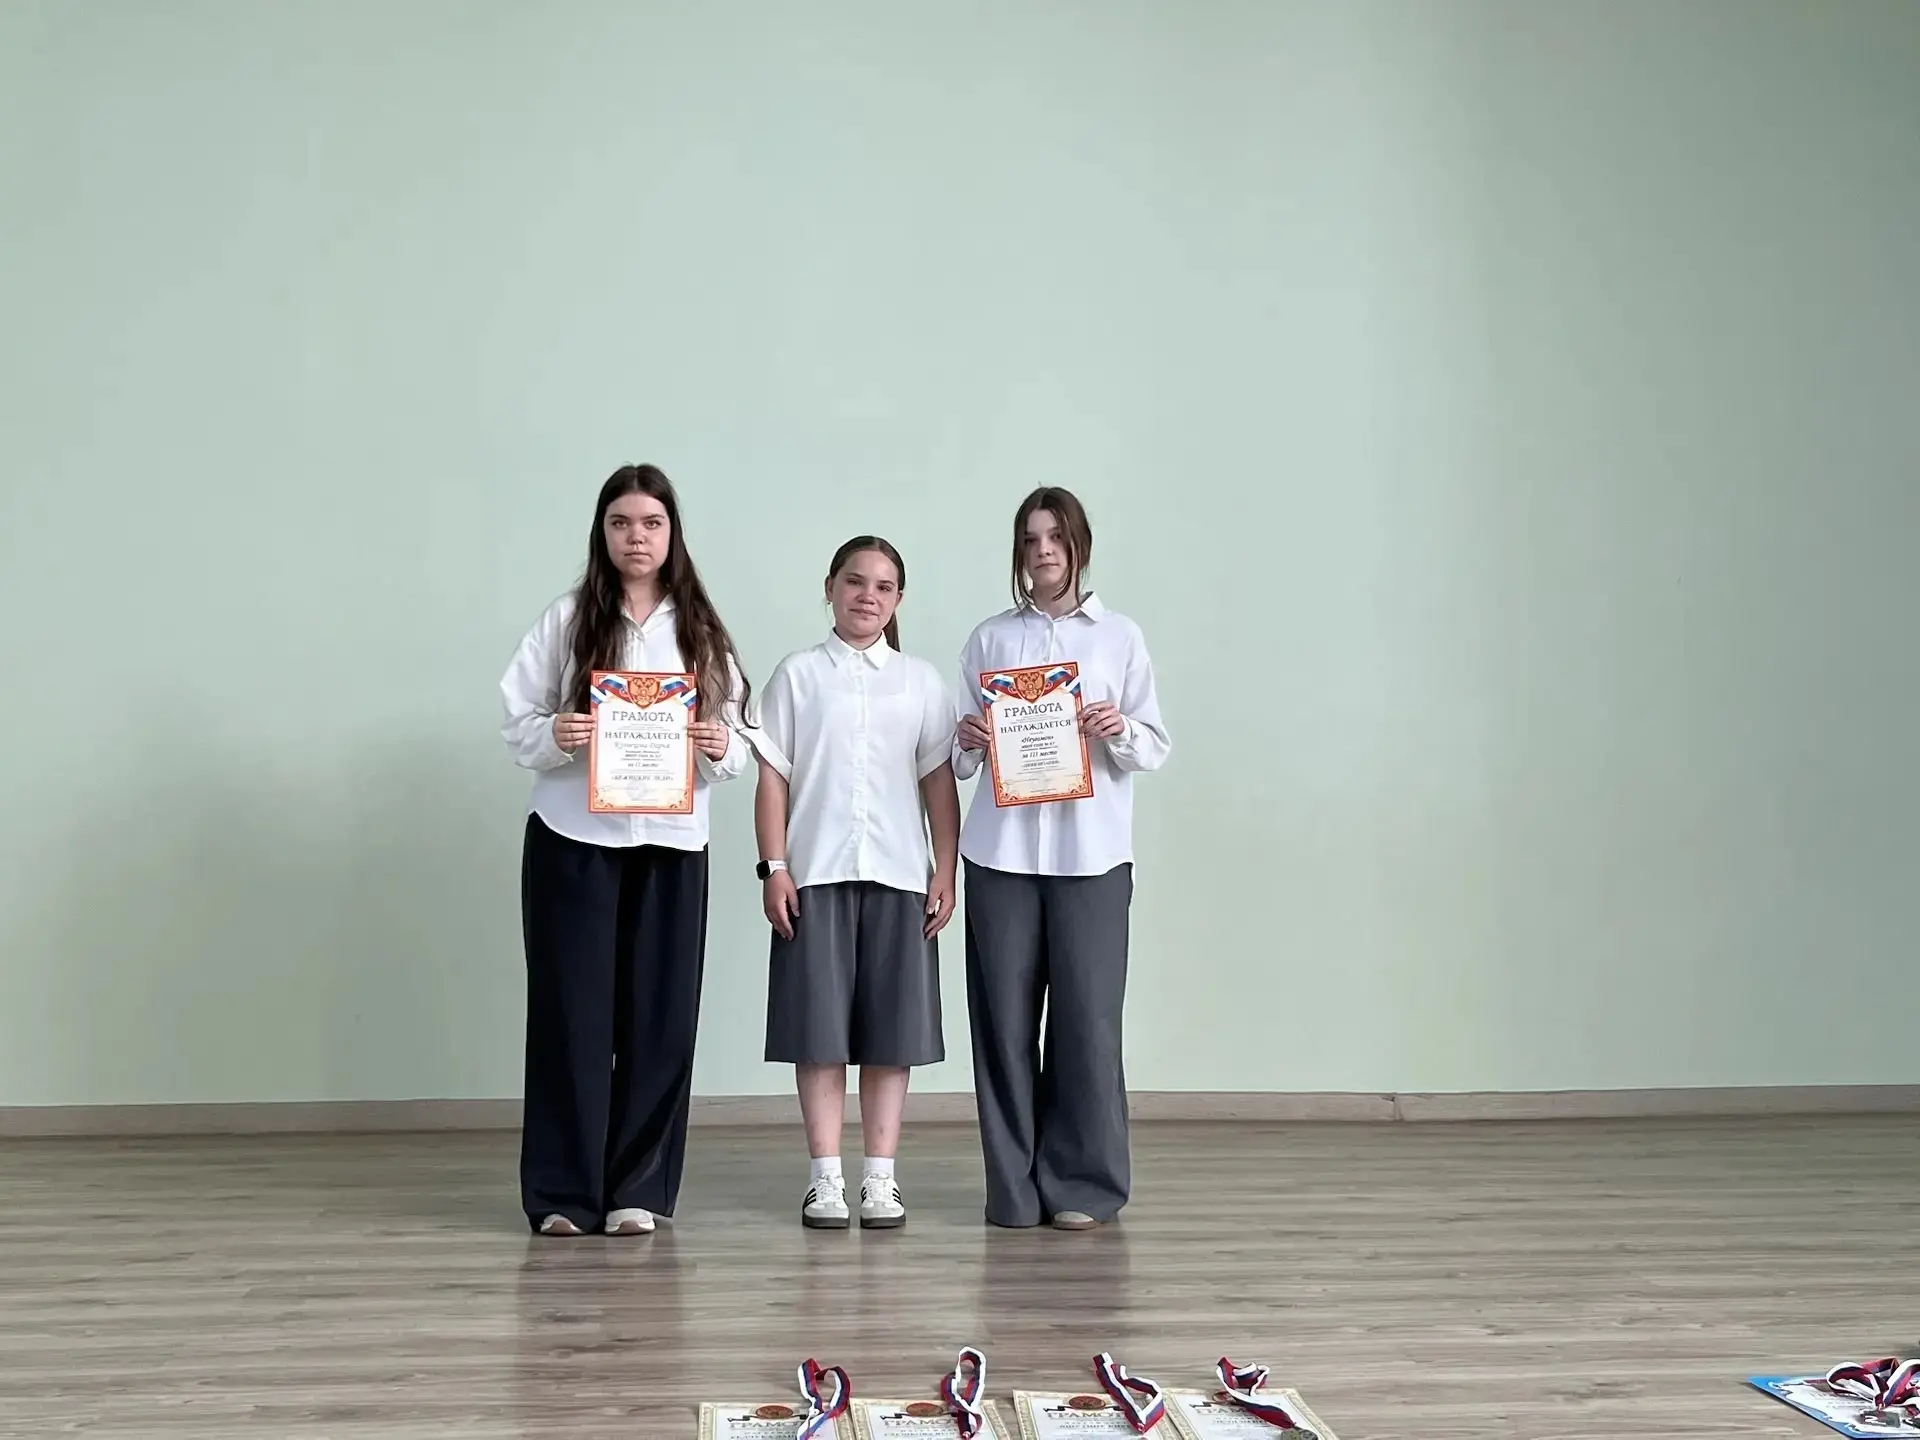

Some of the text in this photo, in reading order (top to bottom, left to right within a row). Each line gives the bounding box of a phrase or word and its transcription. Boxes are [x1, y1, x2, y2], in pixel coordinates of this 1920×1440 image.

[1004, 702, 1063, 717] ГРАМОТА
[612, 711, 674, 722] ГРАМОТА
[1000, 720, 1072, 733] НАГРАЖДАЕТСЯ
[604, 731, 680, 740] НАГРАЖДАЕТСЯ
